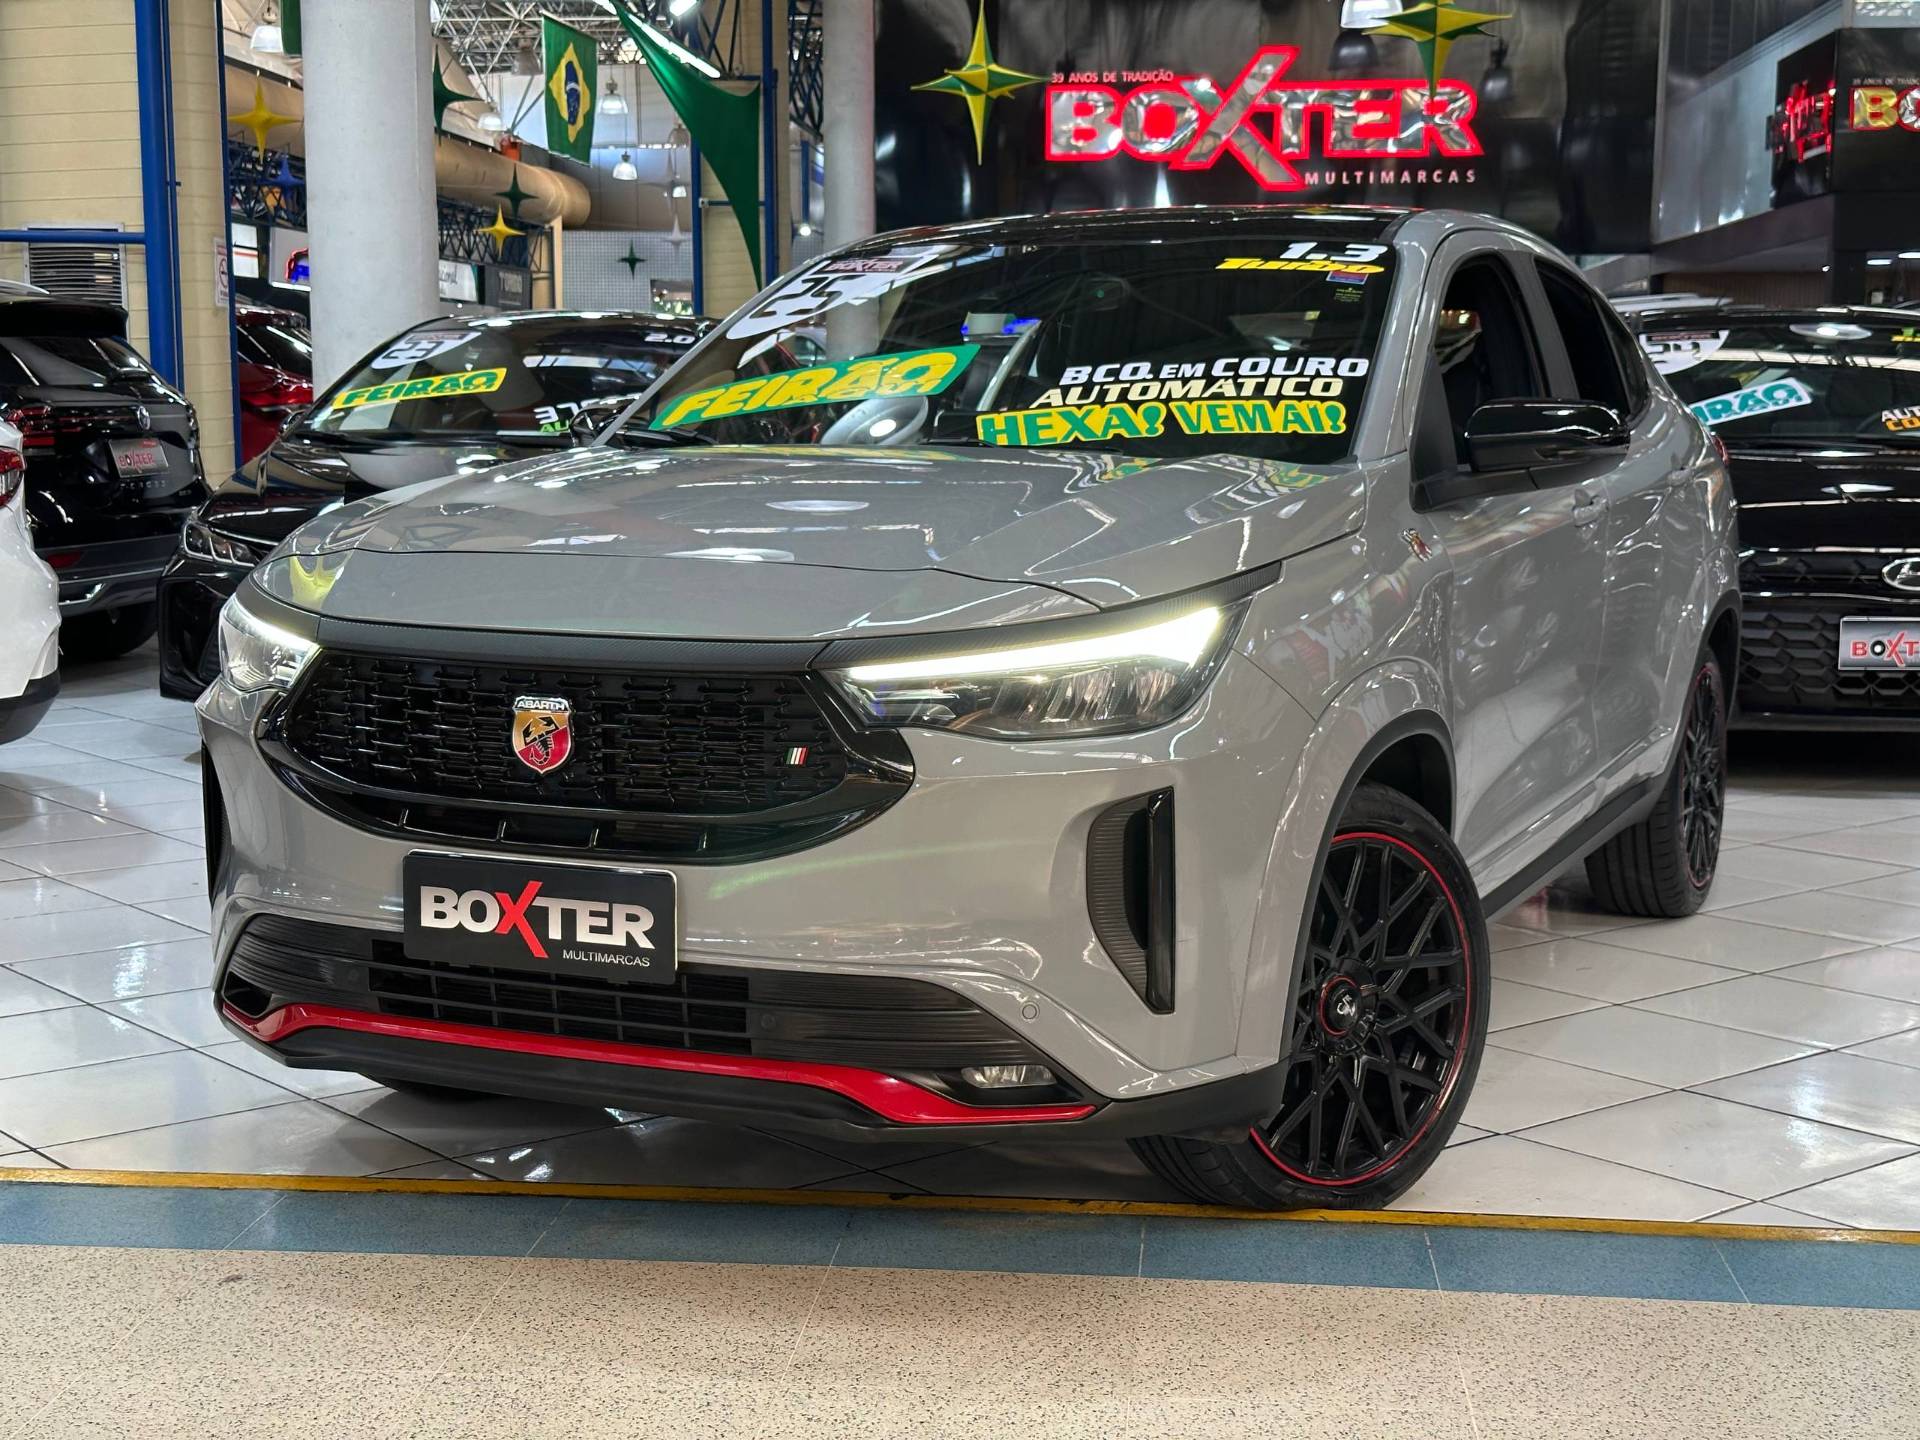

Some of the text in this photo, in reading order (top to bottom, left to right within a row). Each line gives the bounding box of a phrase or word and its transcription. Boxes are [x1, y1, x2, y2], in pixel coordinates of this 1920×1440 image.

[1051, 69, 1174, 83] 39 ANOS DE TRADIÇÃO
[1045, 45, 1484, 191] BOXTER
[1305, 170, 1476, 185] MULTIMARCAS
[1280, 242, 1388, 262] 1.3
[749, 274, 867, 319] 25
[644, 332, 696, 345] 2.0
[1159, 362, 1206, 379] EM
[1211, 357, 1370, 378] COURO
[342, 371, 499, 405] FEIRÃO
[661, 352, 957, 427] FEIRÃO
[1029, 377, 1344, 409] AUTOMÁTICO
[978, 403, 1165, 446] HEXA!
[1174, 403, 1274, 433] VEM
[517, 700, 565, 711] ABARTH
[420, 880, 656, 959] BOXTER
[562, 949, 651, 968] MULTIMARCAS
